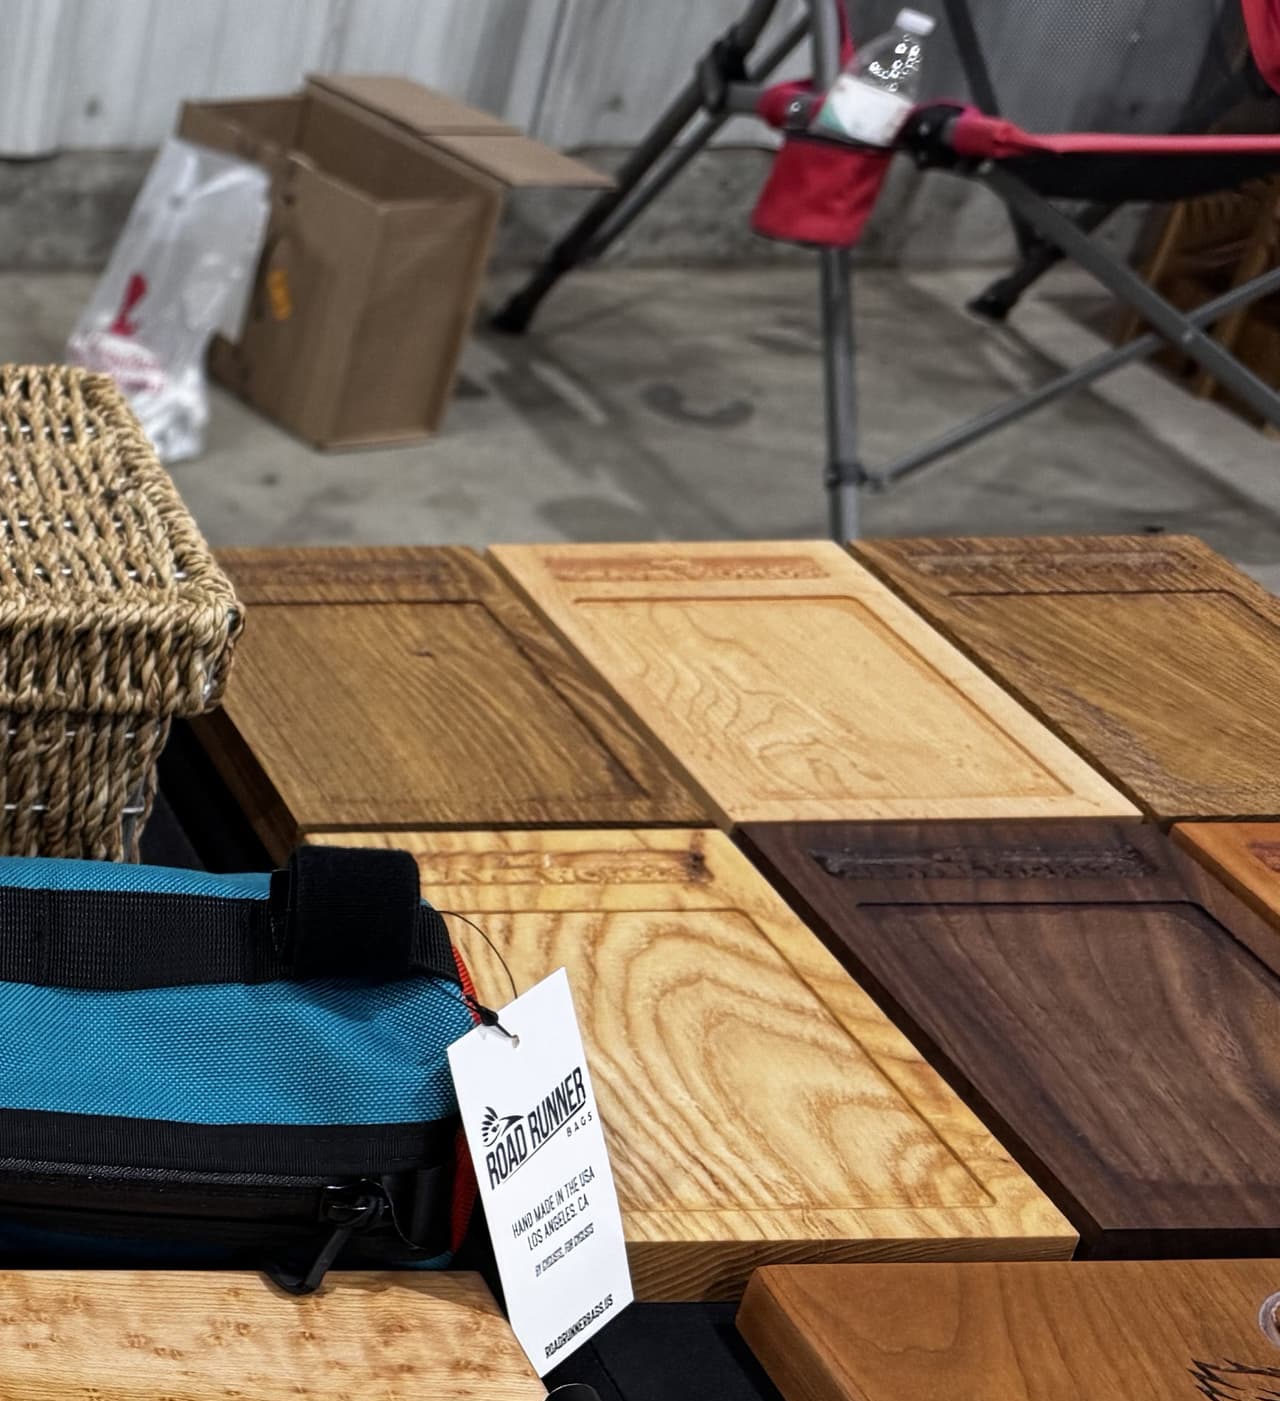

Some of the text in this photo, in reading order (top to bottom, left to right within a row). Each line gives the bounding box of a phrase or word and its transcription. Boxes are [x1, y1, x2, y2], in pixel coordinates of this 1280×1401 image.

[486, 1066, 586, 1190] ROAD RUNNER
[567, 1111, 593, 1137] BAGS
[512, 1165, 595, 1238] HAND MADE IN THE USA
[527, 1229, 543, 1251] LOS
[578, 1193, 590, 1211] CA
